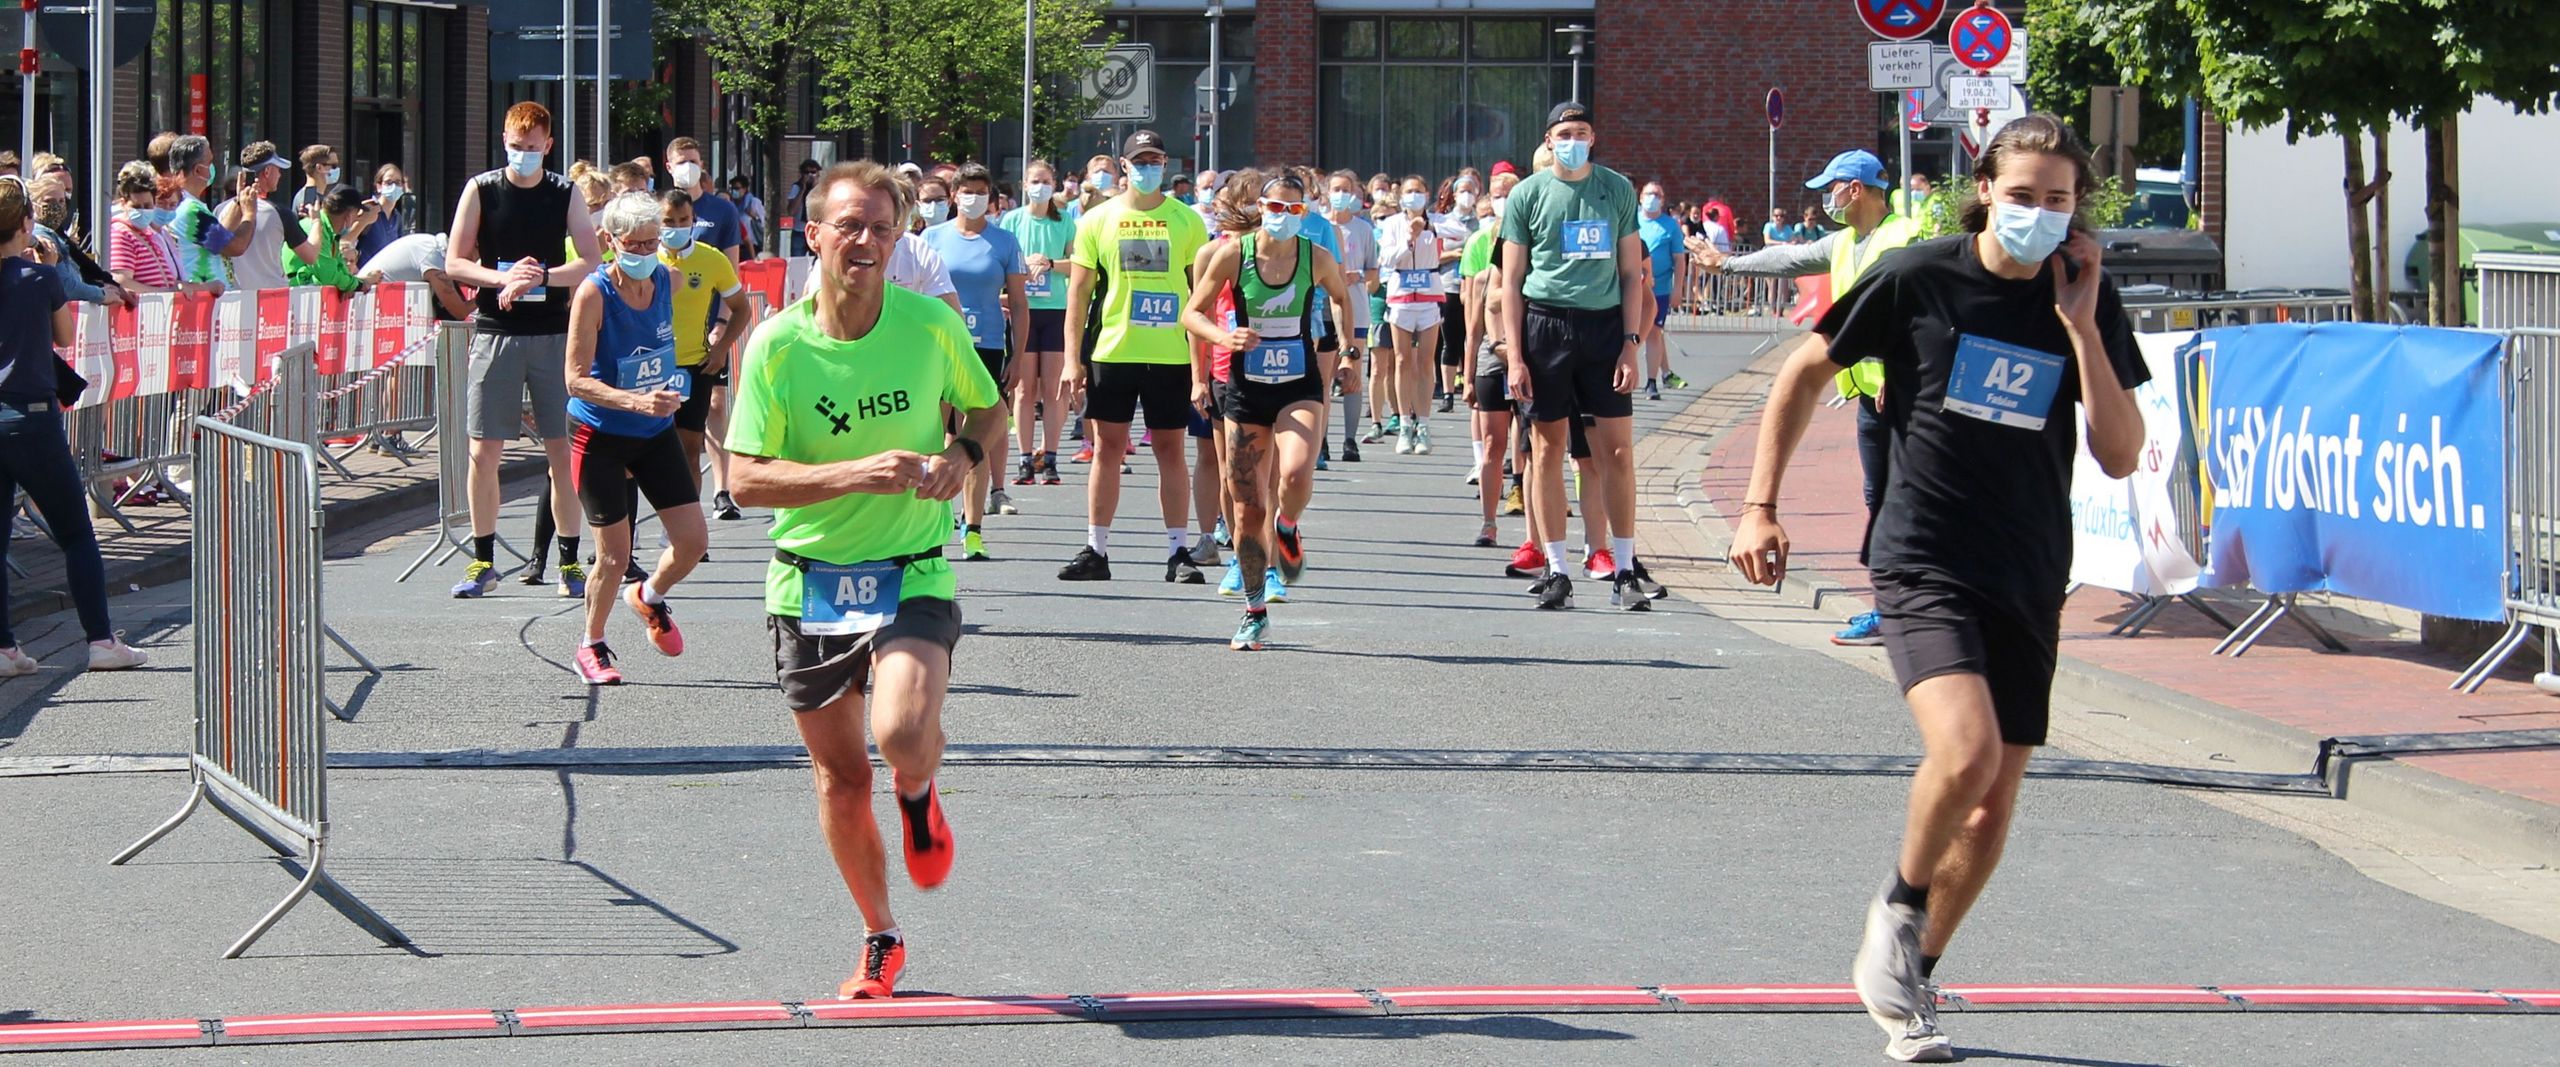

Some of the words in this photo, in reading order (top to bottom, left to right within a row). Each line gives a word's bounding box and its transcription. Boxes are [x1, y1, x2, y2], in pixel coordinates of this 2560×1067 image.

[1881, 48, 1920, 58] Liefer-
[1879, 61, 1923, 71] verkehr
[1101, 67, 1129, 88] 30
[1892, 73, 1912, 83] frei
[1966, 79, 1981, 87] Gilt
[1983, 79, 1993, 87] ab
[1962, 88, 1996, 96] 19.06.21
[1959, 98, 1969, 106] ab
[1972, 98, 1981, 106] 11
[1984, 98, 1999, 106] Uhr
[1098, 104, 1133, 115] ZONE
[1940, 109, 1967, 118] ZON
[1119, 229, 1168, 237] Cuxhaven
[1577, 227, 1601, 245] A9
[1406, 273, 1426, 284] A54
[1140, 298, 1173, 315] A14
[1262, 348, 1290, 368] A6
[636, 357, 662, 380] A3
[1983, 356, 2034, 397] A2
[857, 389, 911, 420] HSB
[1986, 392, 2019, 409] Fabian
[2265, 405, 2363, 520] lohnt
[2372, 412, 2486, 530] sich.
[834, 575, 878, 606] A8
